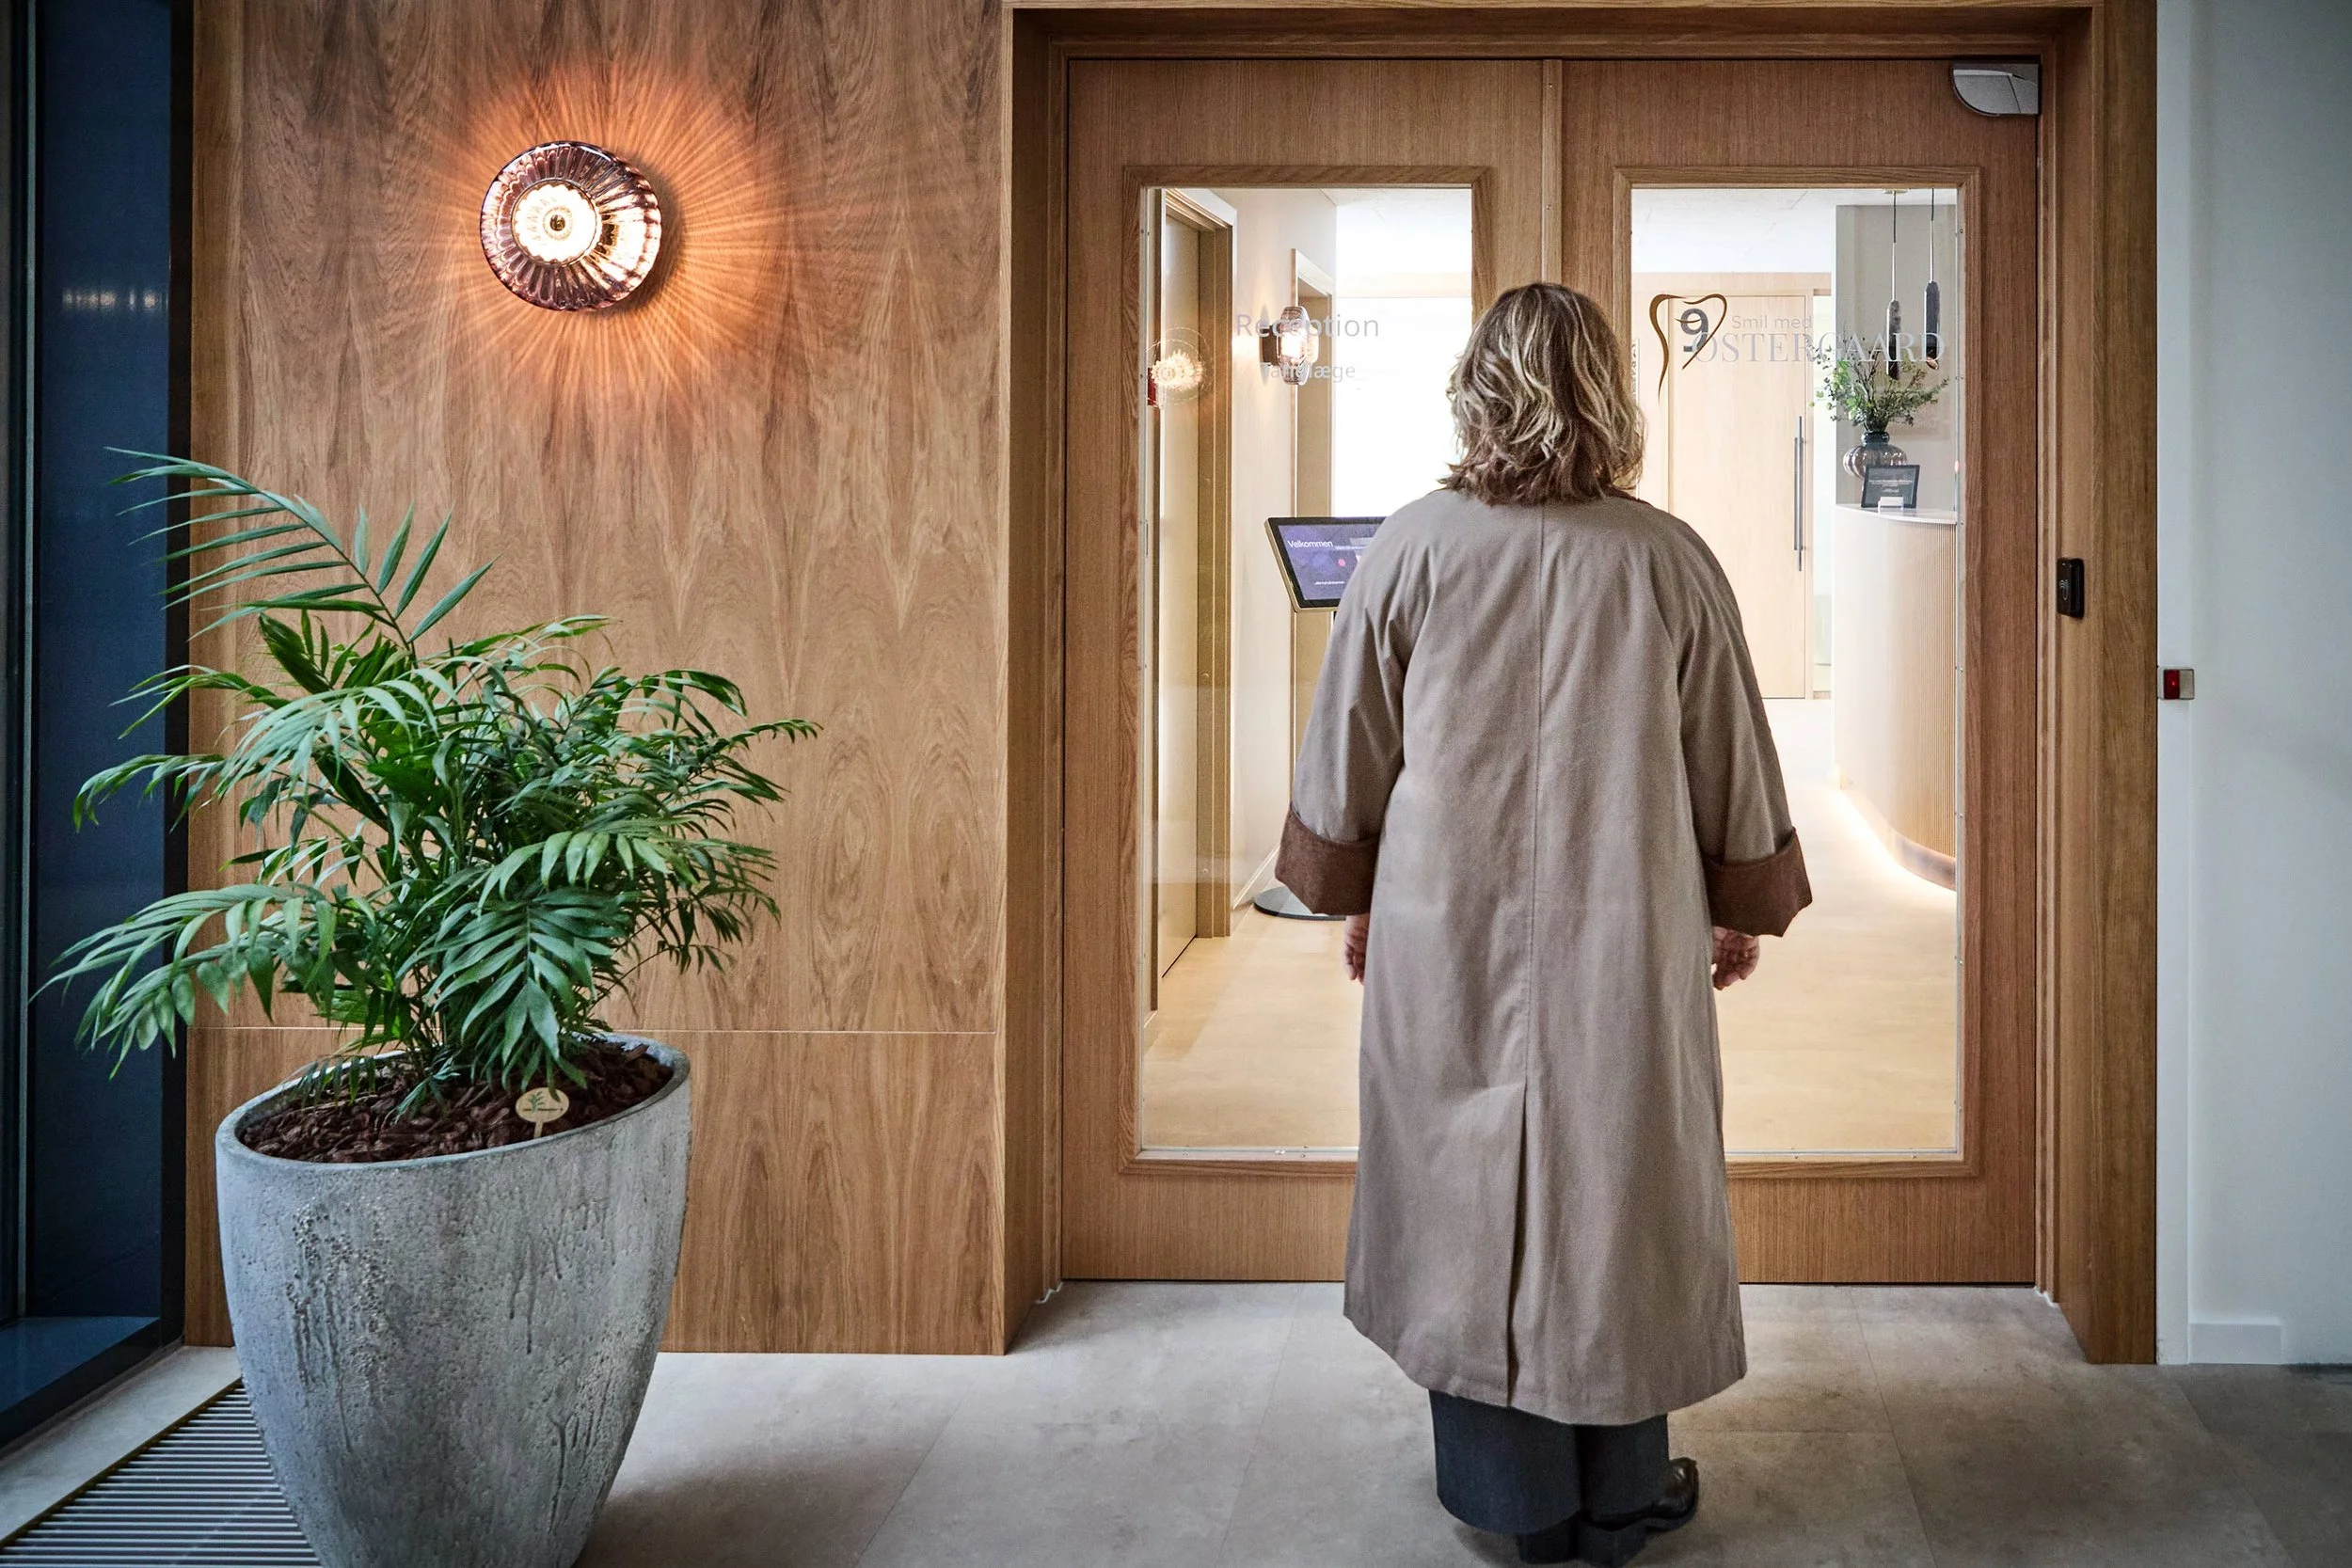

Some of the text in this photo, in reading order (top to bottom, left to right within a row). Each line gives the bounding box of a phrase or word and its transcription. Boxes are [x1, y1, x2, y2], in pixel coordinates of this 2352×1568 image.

[1236, 313, 1379, 342] Reception
[1731, 315, 1812, 329] Smil med
[1287, 540, 1333, 548] Velkommen
